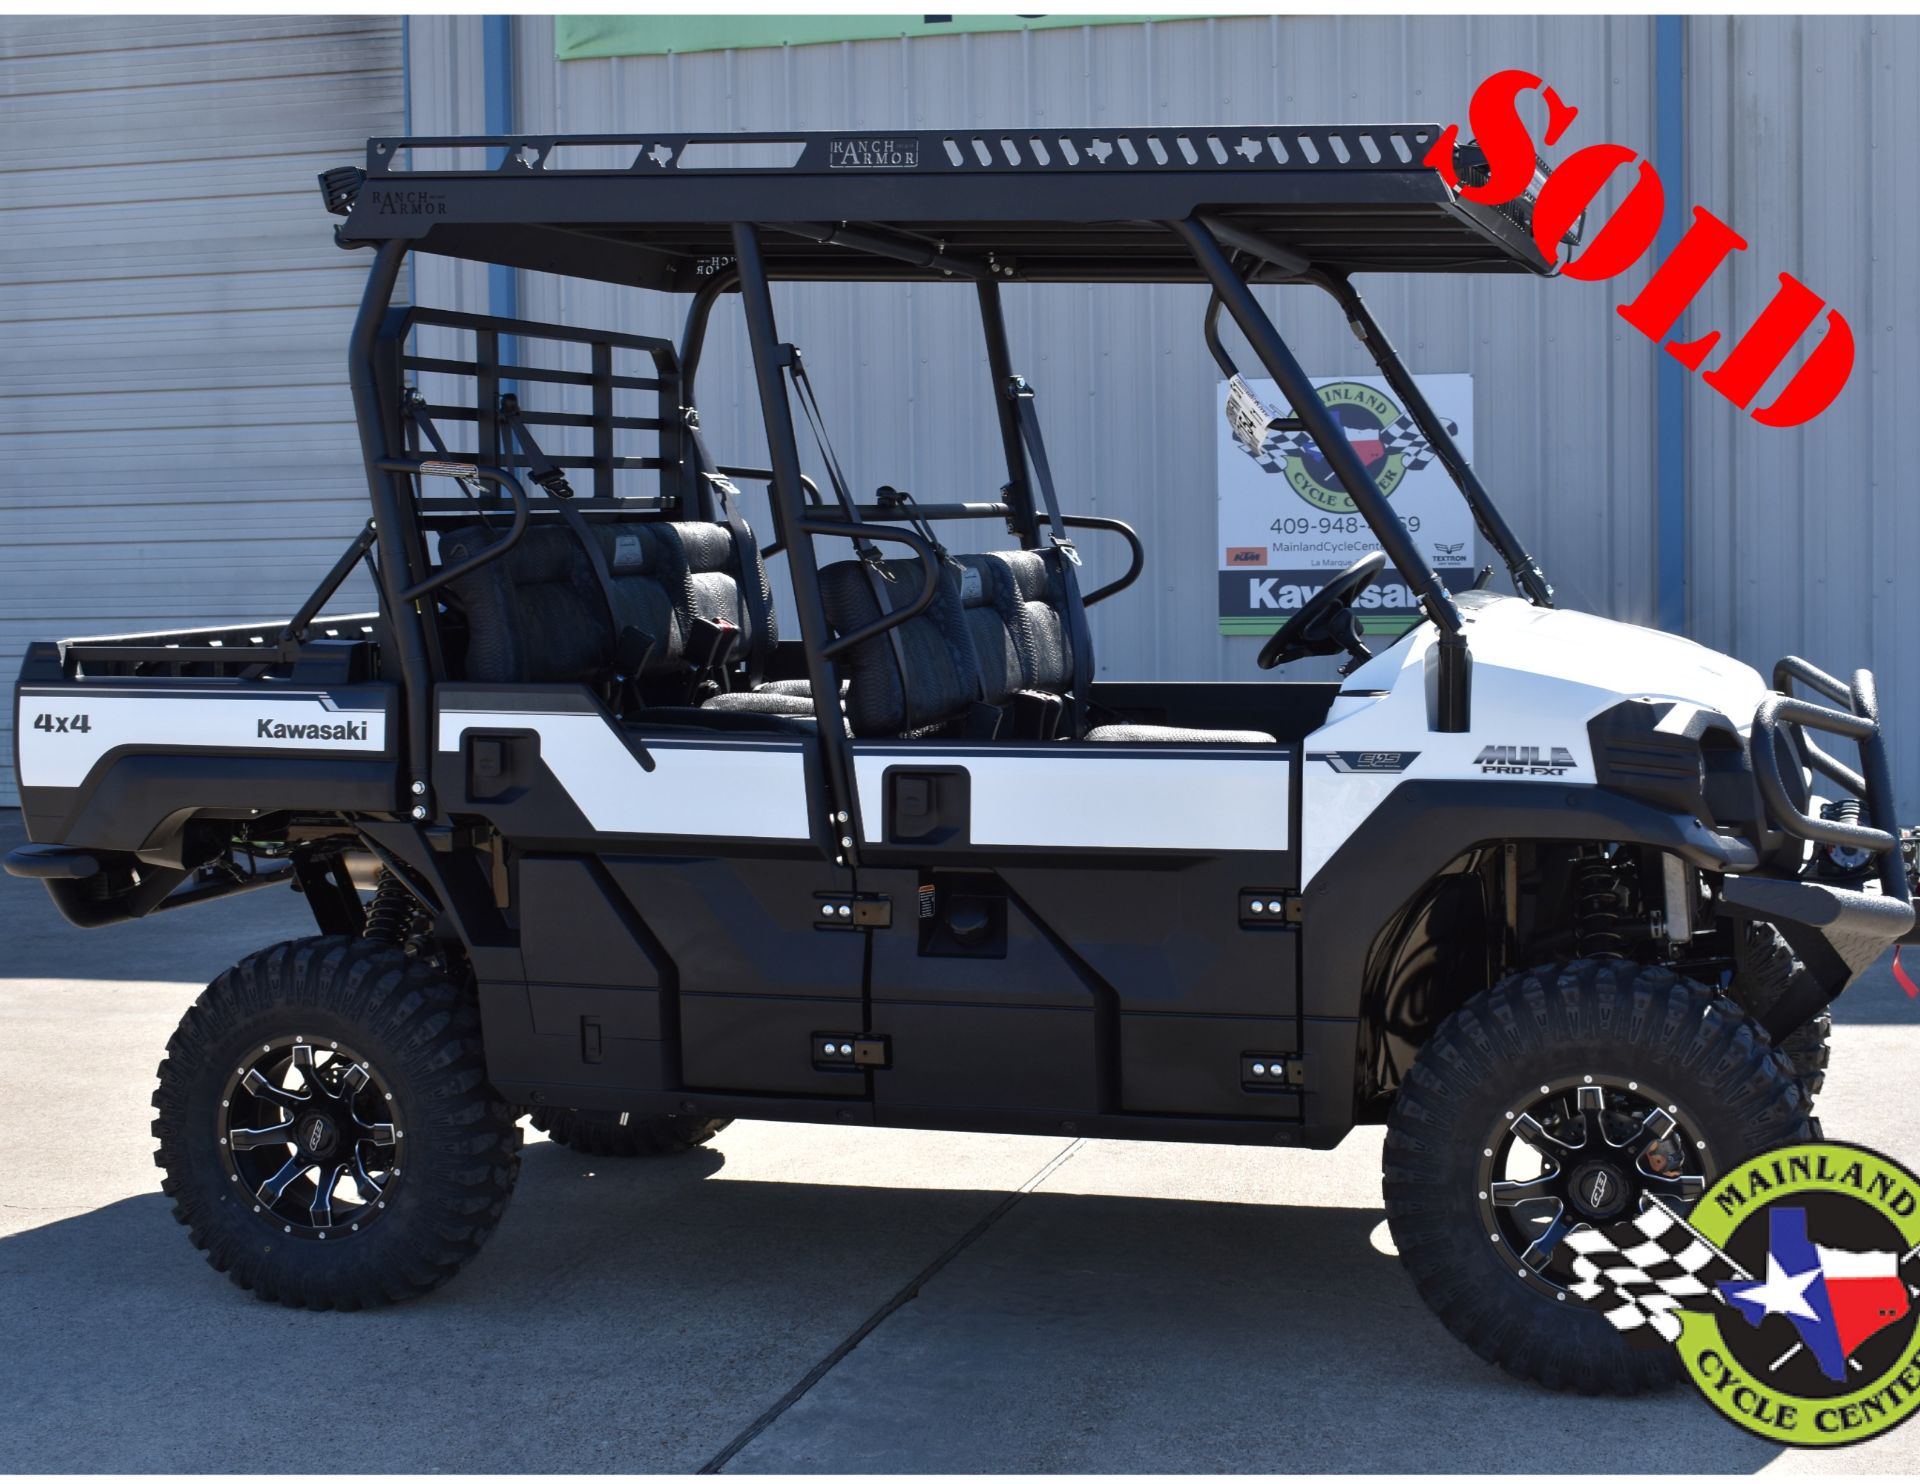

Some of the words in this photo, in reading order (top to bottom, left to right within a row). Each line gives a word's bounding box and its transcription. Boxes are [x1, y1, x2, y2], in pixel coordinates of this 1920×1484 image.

[833, 141, 895, 156] RANCH
[841, 142, 915, 165] ARMOR
[372, 191, 428, 205] RANCH
[379, 191, 447, 214] ARMOR
[1321, 388, 1388, 416] INLAND
[1294, 472, 1338, 507] CYCLE
[1344, 468, 1398, 508] CER
[1311, 559, 1321, 567] La
[33, 713, 92, 734] 4x4
[257, 719, 368, 741] Kawasaki
[1472, 745, 1578, 767] MULE
[1482, 765, 1568, 776] PRO-FXT
